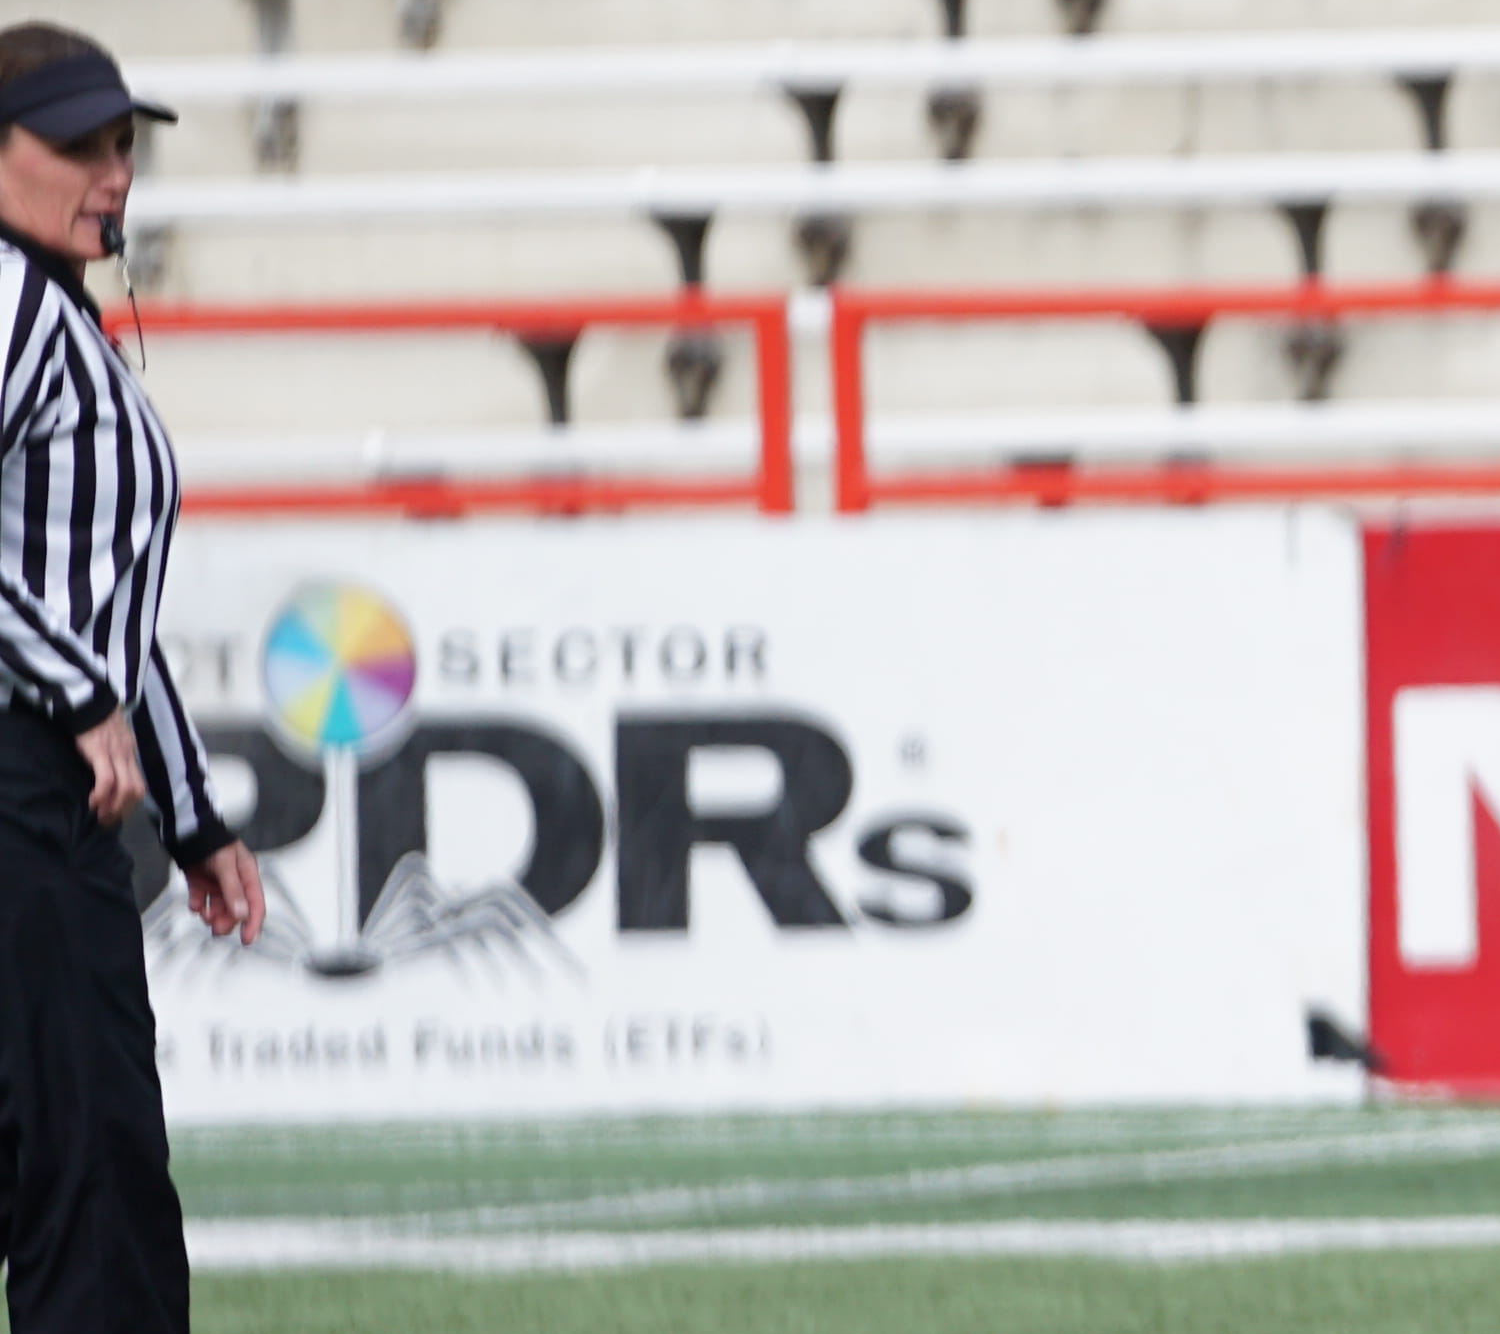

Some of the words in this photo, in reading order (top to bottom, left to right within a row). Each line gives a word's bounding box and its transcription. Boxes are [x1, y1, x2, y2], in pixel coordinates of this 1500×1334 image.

[438, 625, 770, 686] SECTOR
[208, 1020, 388, 1069] Traded
[413, 1019, 574, 1065] Funds
